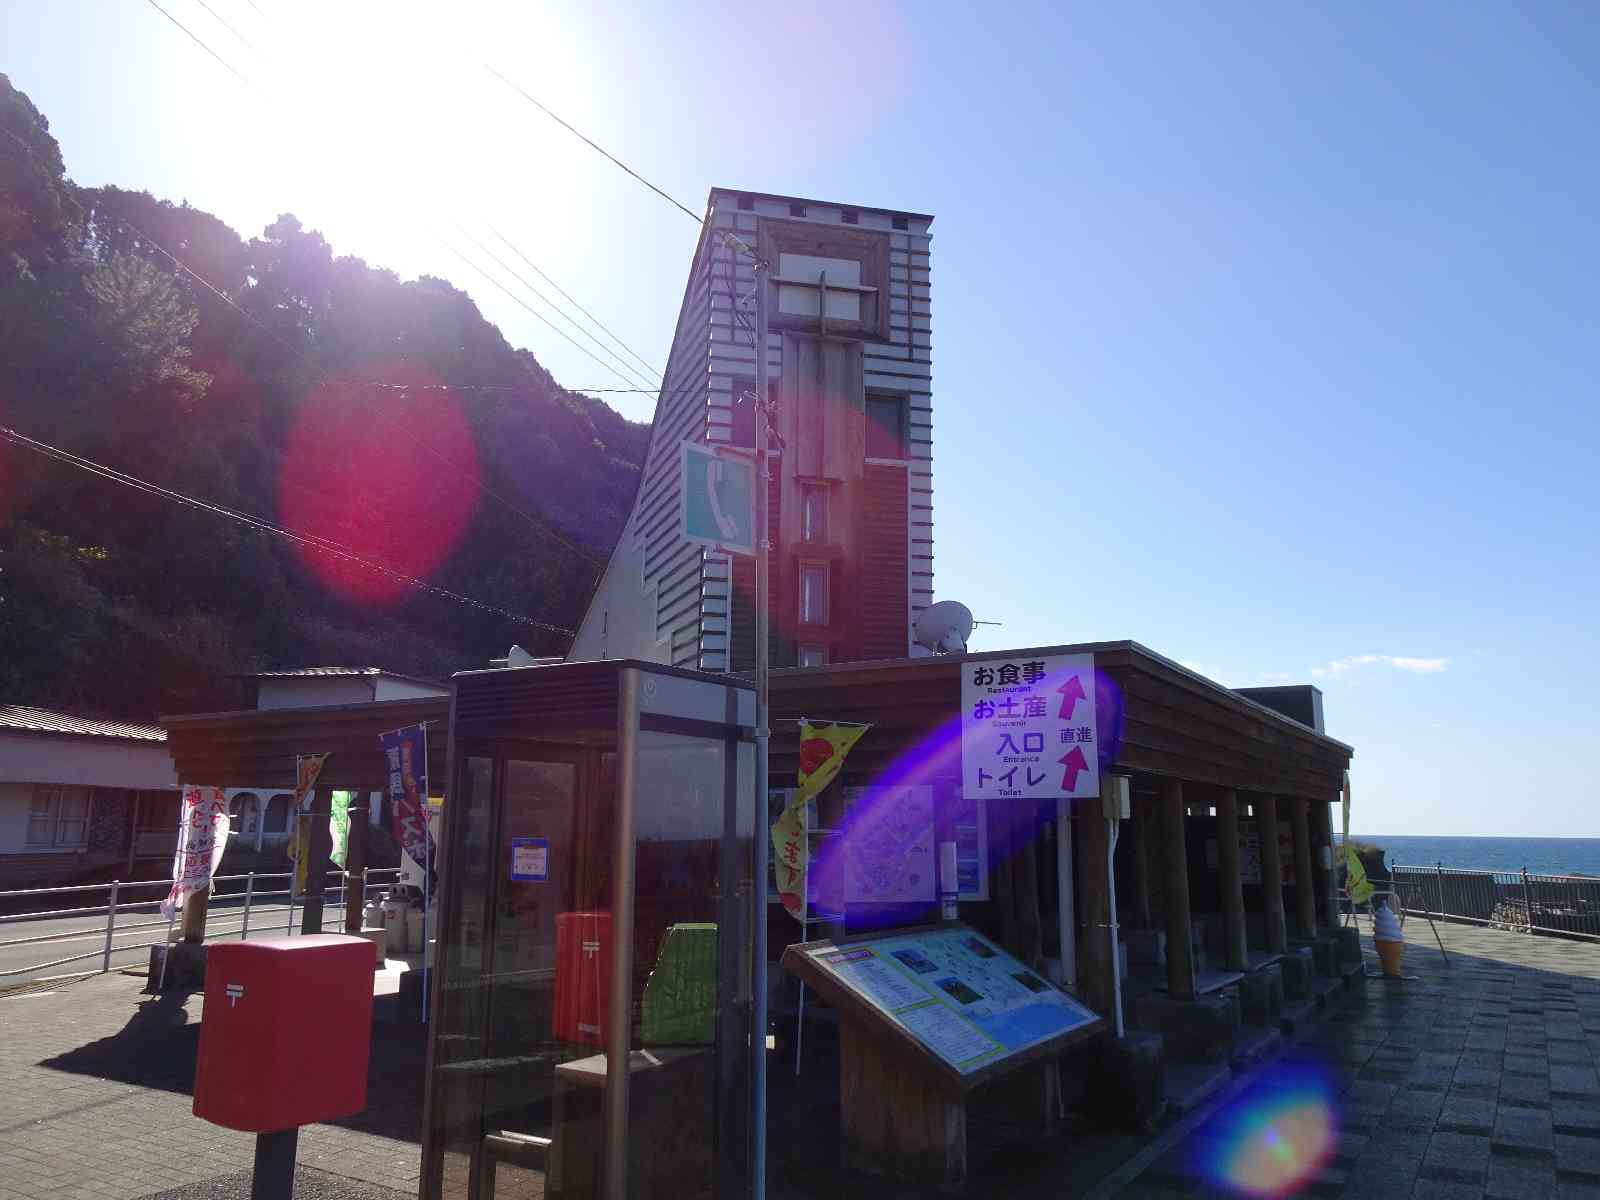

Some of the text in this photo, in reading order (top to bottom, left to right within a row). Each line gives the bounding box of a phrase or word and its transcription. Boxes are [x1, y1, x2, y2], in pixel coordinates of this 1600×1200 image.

[973, 661, 1046, 686] お食事
[987, 686, 1031, 694] Restaurant
[974, 696, 1048, 719] お土産
[996, 733, 1044, 754] 入口
[1060, 727, 1093, 743] 直進
[978, 766, 1047, 788] トイレ
[999, 788, 1022, 796] Toilet
